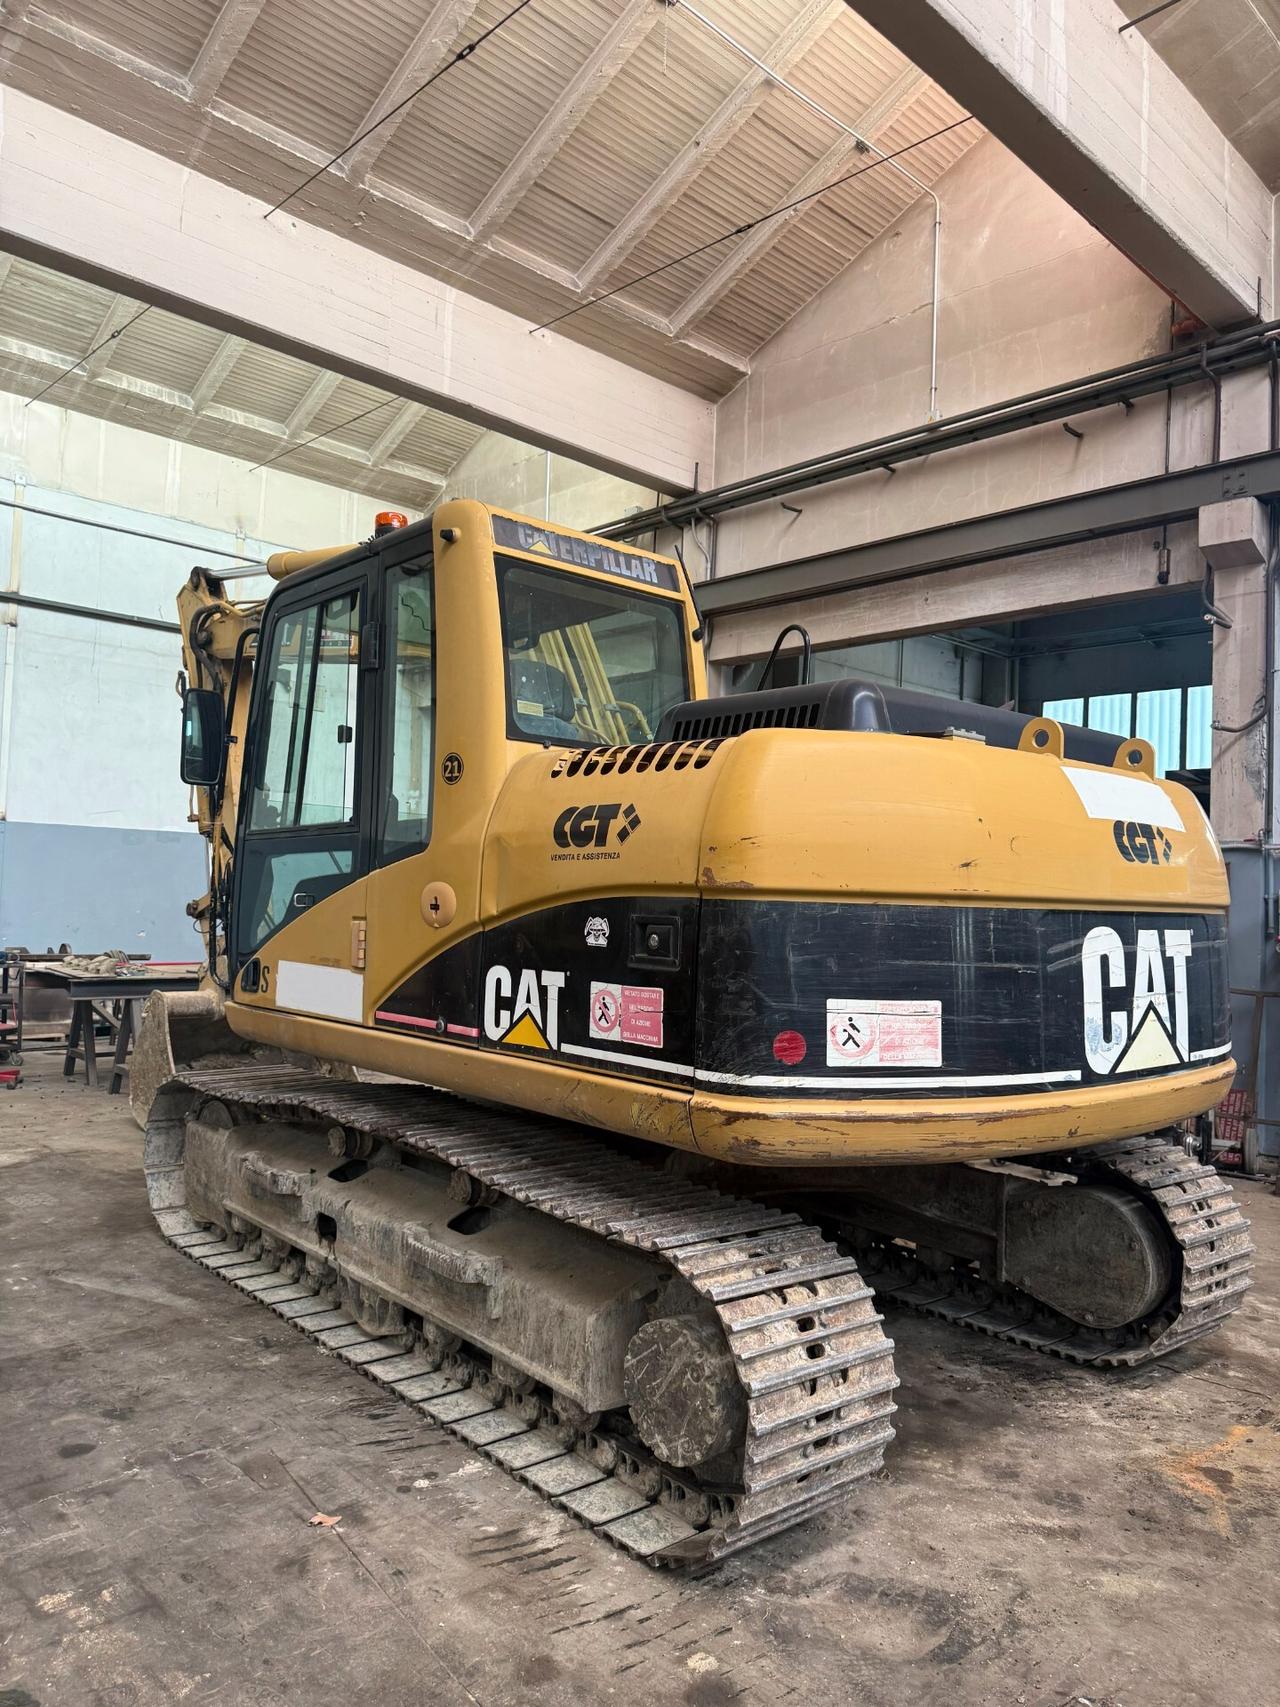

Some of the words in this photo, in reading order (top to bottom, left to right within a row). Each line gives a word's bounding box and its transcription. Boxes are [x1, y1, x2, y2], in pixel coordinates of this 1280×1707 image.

[518, 525, 658, 583] CATERPILLAR
[444, 761, 460, 777] 21
[553, 803, 622, 848] CGT
[1113, 820, 1160, 865] CGT
[582, 852, 621, 860] ASSISTENZA
[484, 965, 566, 1050] CAT
[1082, 926, 1192, 1074] CAT
